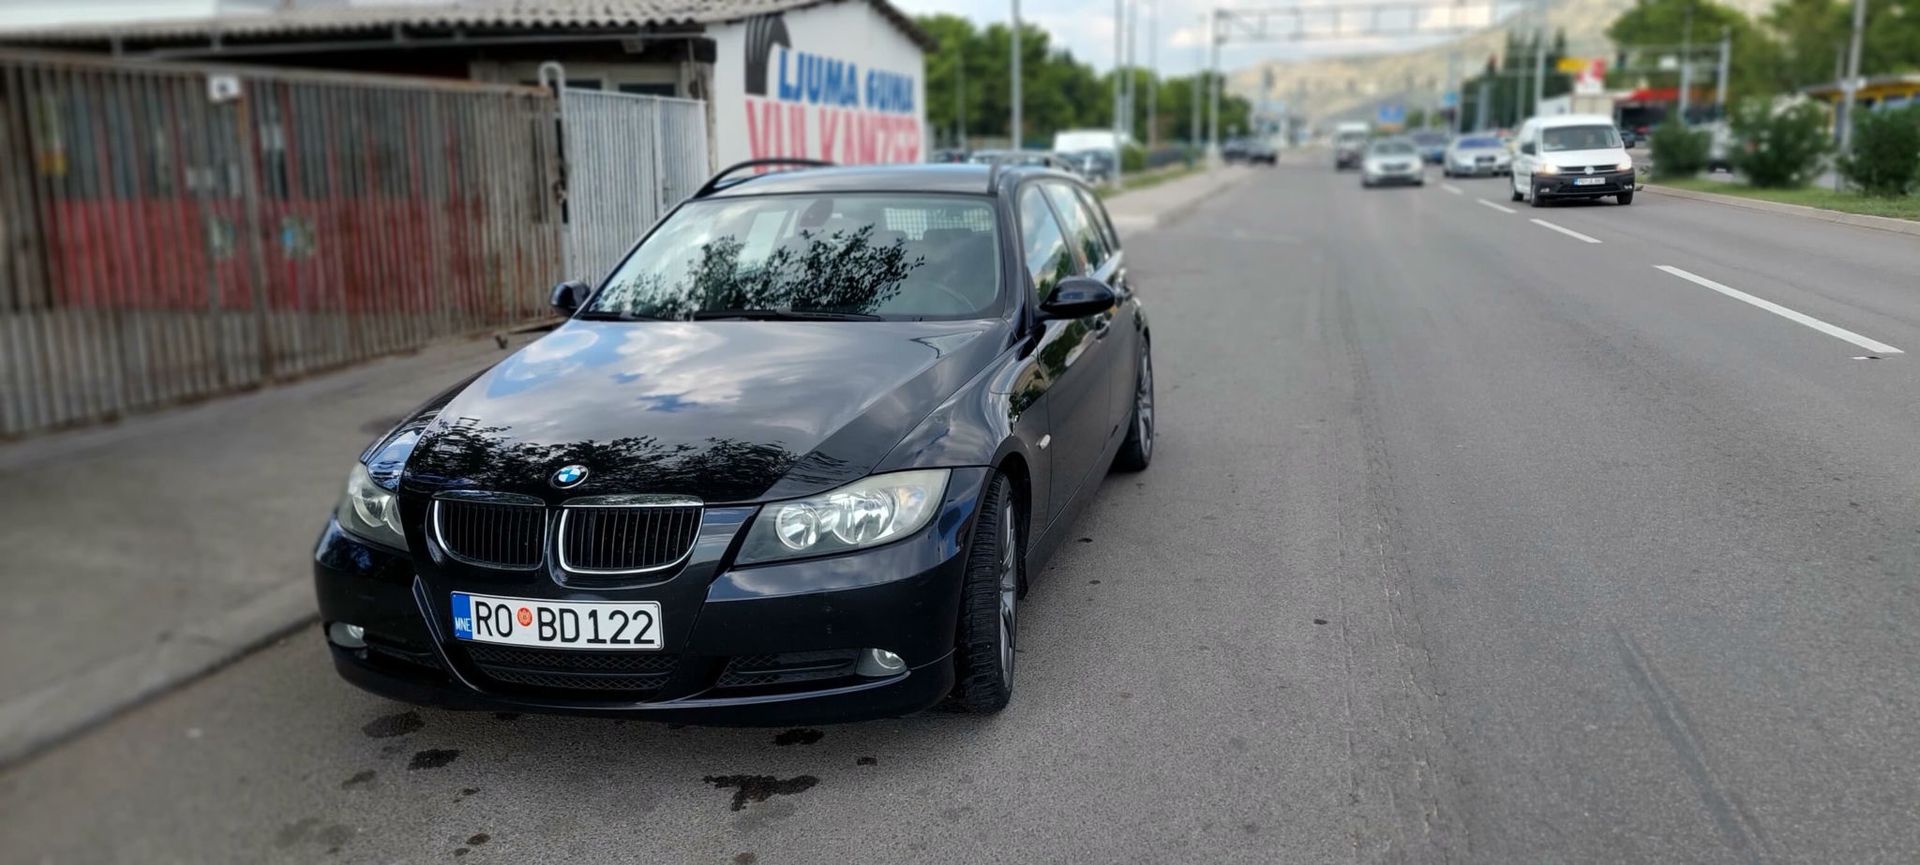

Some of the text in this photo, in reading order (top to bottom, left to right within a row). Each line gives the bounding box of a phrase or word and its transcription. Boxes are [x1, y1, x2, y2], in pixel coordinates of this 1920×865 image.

[454, 600, 655, 645] MNE RO BD122
